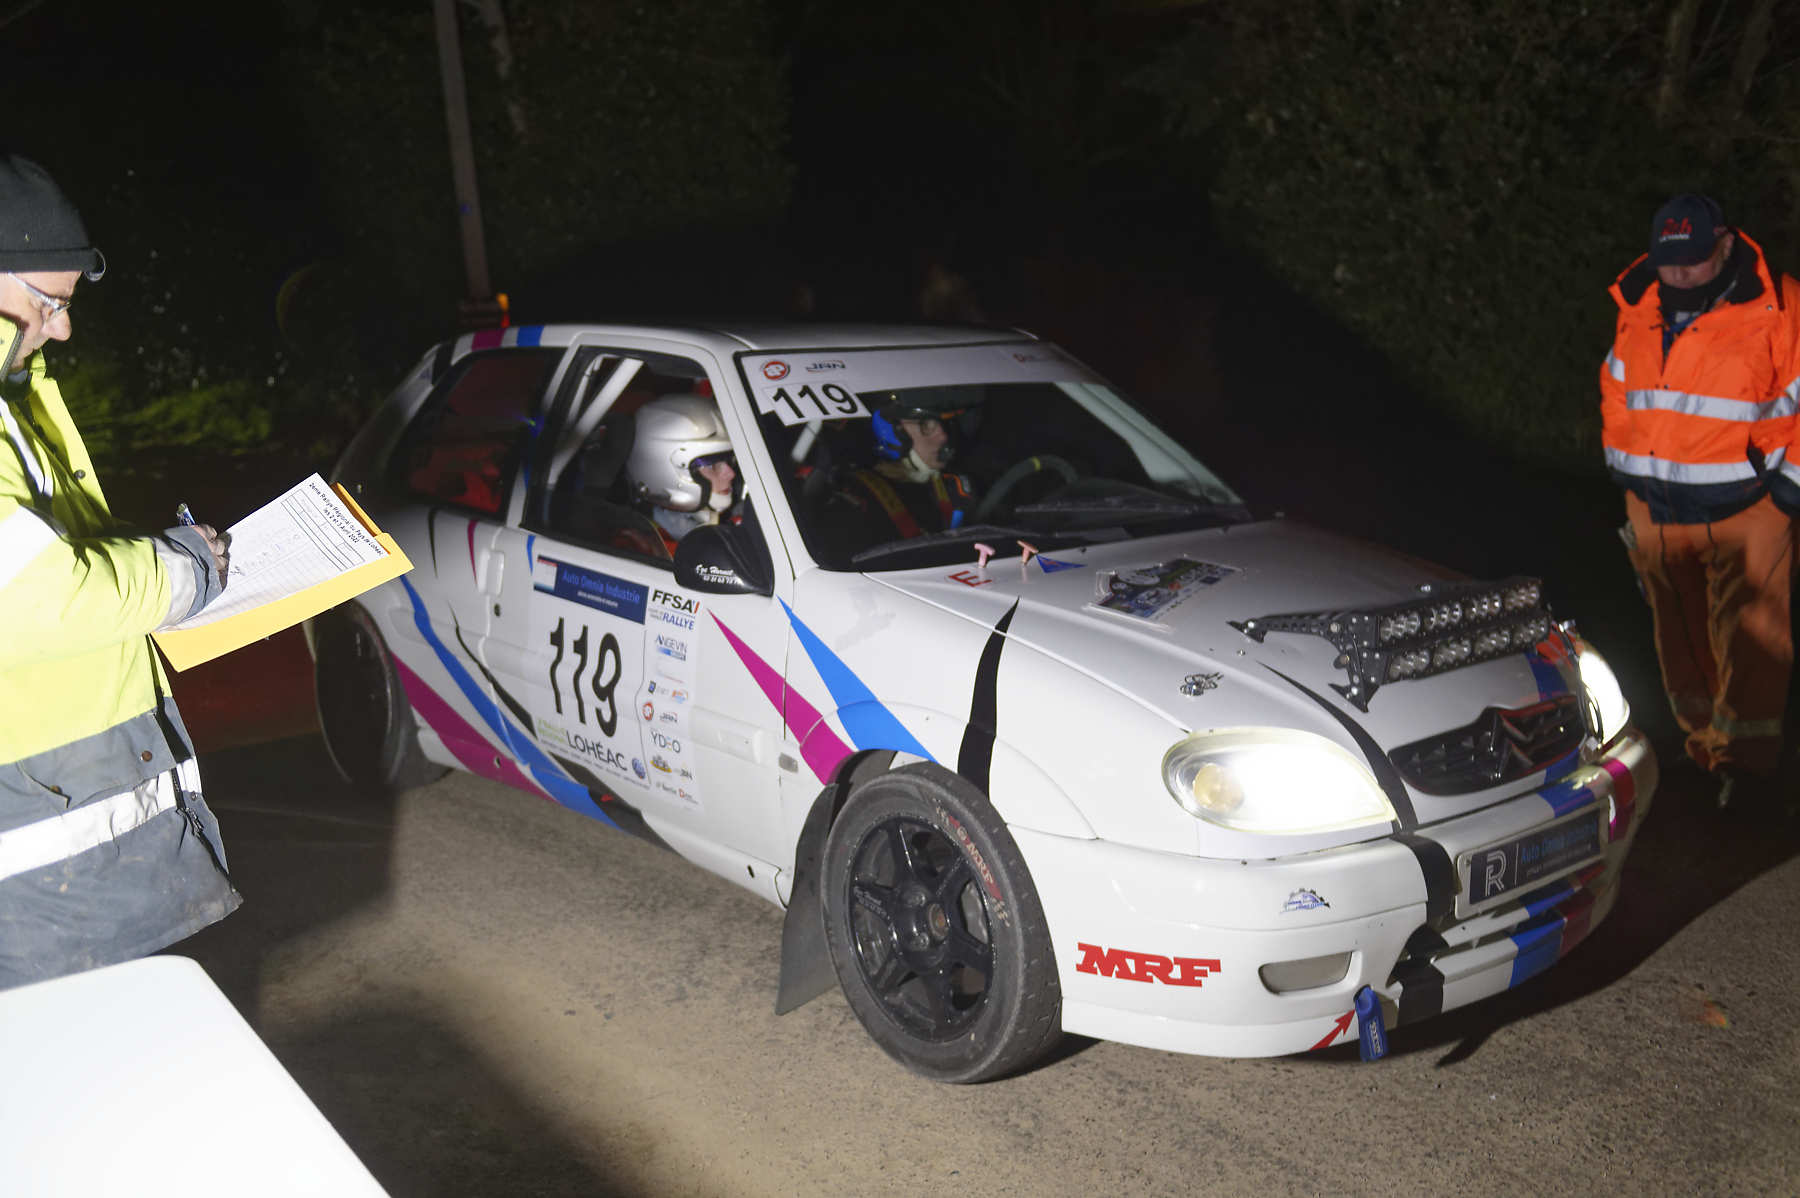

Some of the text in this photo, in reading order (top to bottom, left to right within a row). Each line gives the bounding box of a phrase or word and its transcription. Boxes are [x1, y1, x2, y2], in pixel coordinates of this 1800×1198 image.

[772, 383, 858, 419] 119
[562, 568, 579, 587] Auto
[652, 589, 693, 614] FFSA
[662, 612, 695, 630] RALLYE
[550, 616, 622, 738] 119
[566, 730, 628, 772] LOHÉAC
[1076, 941, 1222, 988] MRF
